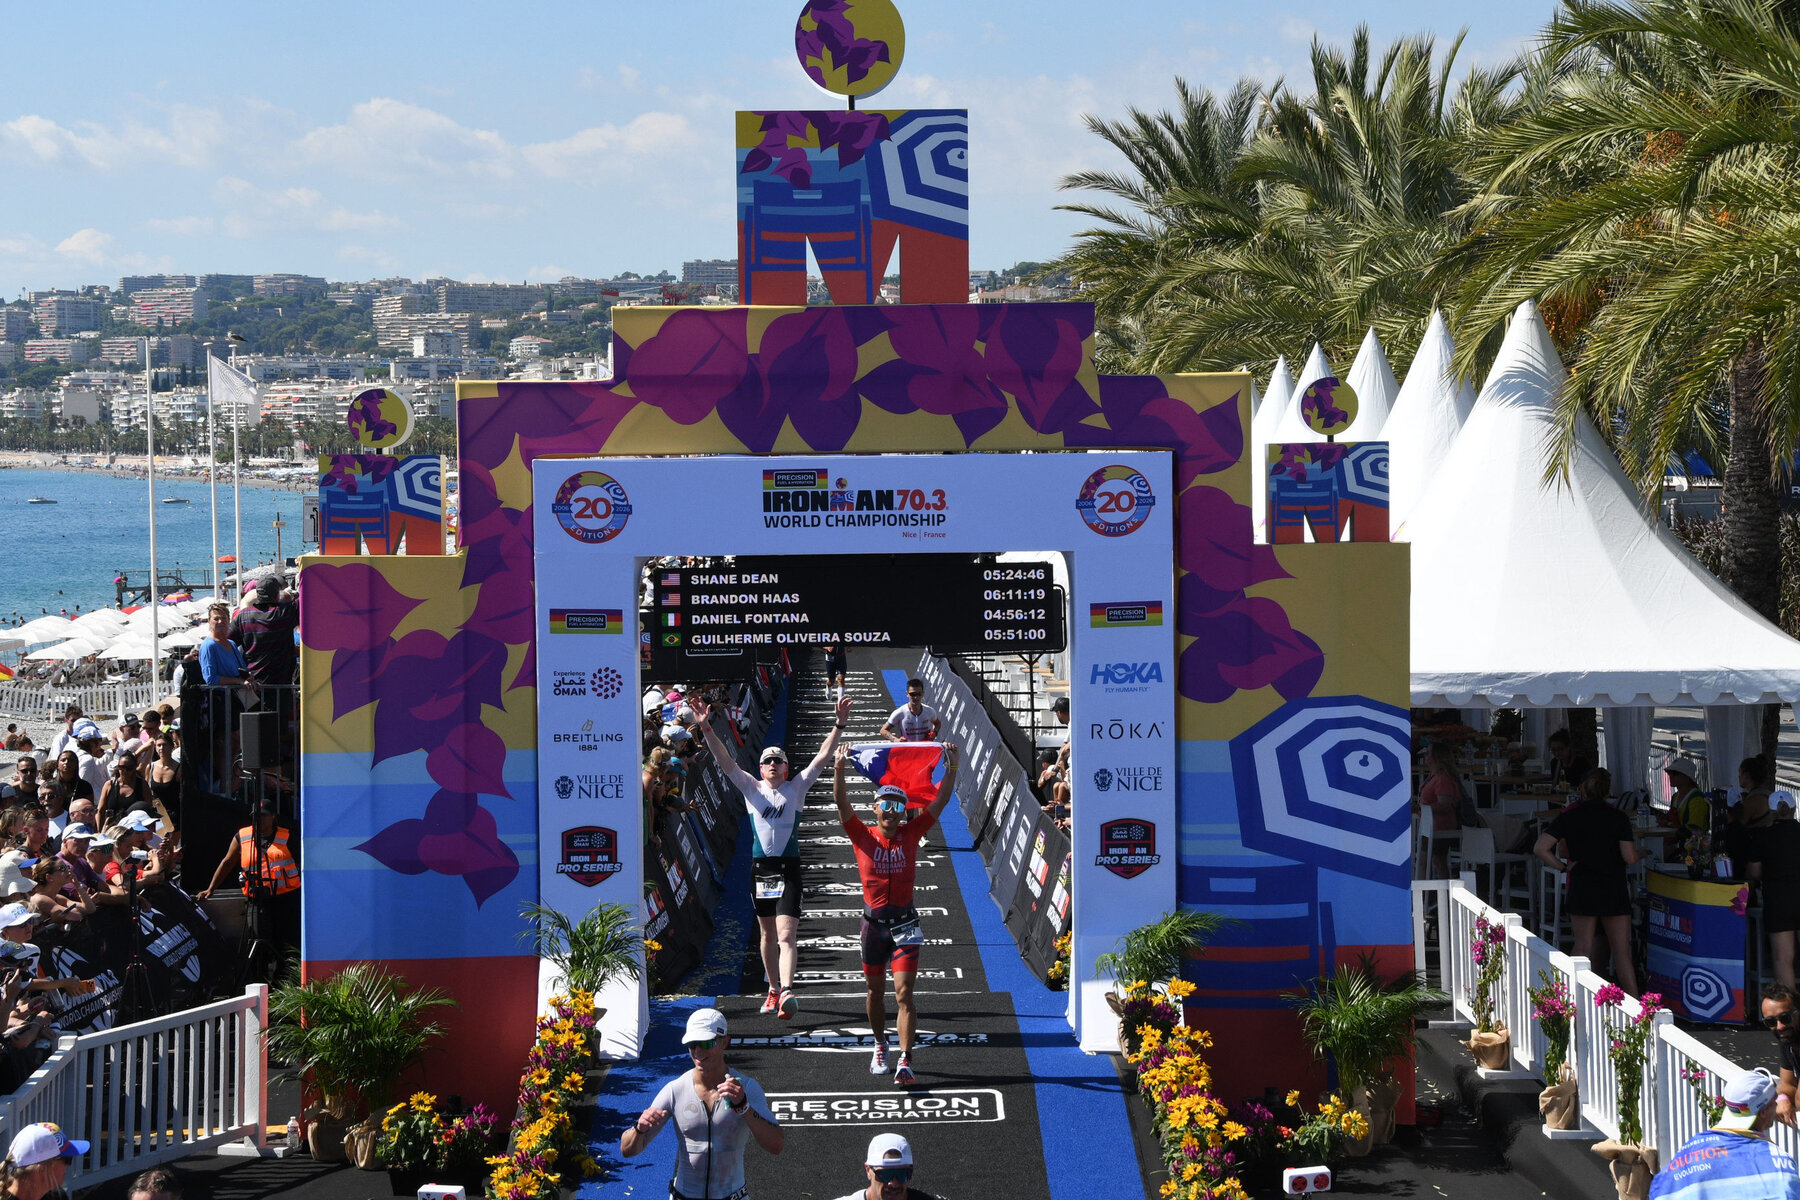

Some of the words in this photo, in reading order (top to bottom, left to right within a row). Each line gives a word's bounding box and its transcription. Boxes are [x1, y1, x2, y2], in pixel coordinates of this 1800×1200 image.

[573, 497, 612, 519] 20
[1097, 491, 1135, 513] 20
[764, 515, 821, 528] WORLD
[825, 513, 946, 527] CHAMPIONSHIP
[1092, 518, 1138, 532] EDITIONS
[570, 524, 616, 539] EDITIONS
[690, 574, 738, 585] SHANE
[741, 573, 779, 584] DEAN
[983, 569, 1045, 581] 05:24:46
[691, 594, 758, 605] BRANDON
[763, 593, 800, 604] HAAS
[983, 589, 1045, 600] 06:11:19
[691, 613, 741, 625] DANIEL
[745, 612, 809, 624] FONTANA
[983, 609, 1046, 621] 04:56:12
[691, 633, 772, 645] GUILHERME
[776, 632, 840, 644] OLIVEIRA
[843, 632, 891, 642] SOUZA
[984, 629, 1046, 641] 05:51:00
[1090, 662, 1163, 684] HOKA
[553, 688, 587, 696] OMAN
[553, 733, 624, 742] BREITLING
[1115, 767, 1144, 776] VILLE
[1147, 767, 1162, 776] DE
[577, 775, 608, 783] VILLE
[609, 775, 624, 783] DE
[1117, 776, 1162, 791] NICE
[578, 784, 624, 799] NICE
[873, 845, 906, 863] DARK
[1096, 856, 1120, 865] PRO
[1120, 855, 1159, 864] SERIES
[557, 864, 581, 873] PRO
[582, 863, 622, 872] SERIES
[873, 861, 906, 869] ENDURANCE
[59, 1009, 82, 1028] WORLD
[771, 1097, 979, 1113] RECISION
[775, 1112, 798, 1120] EL
[812, 1112, 827, 1120] &
[834, 1109, 980, 1120] HYDRATION
[1669, 1146, 1729, 1171] OLUTION
[1673, 1162, 1712, 1181] EVOLUTION
